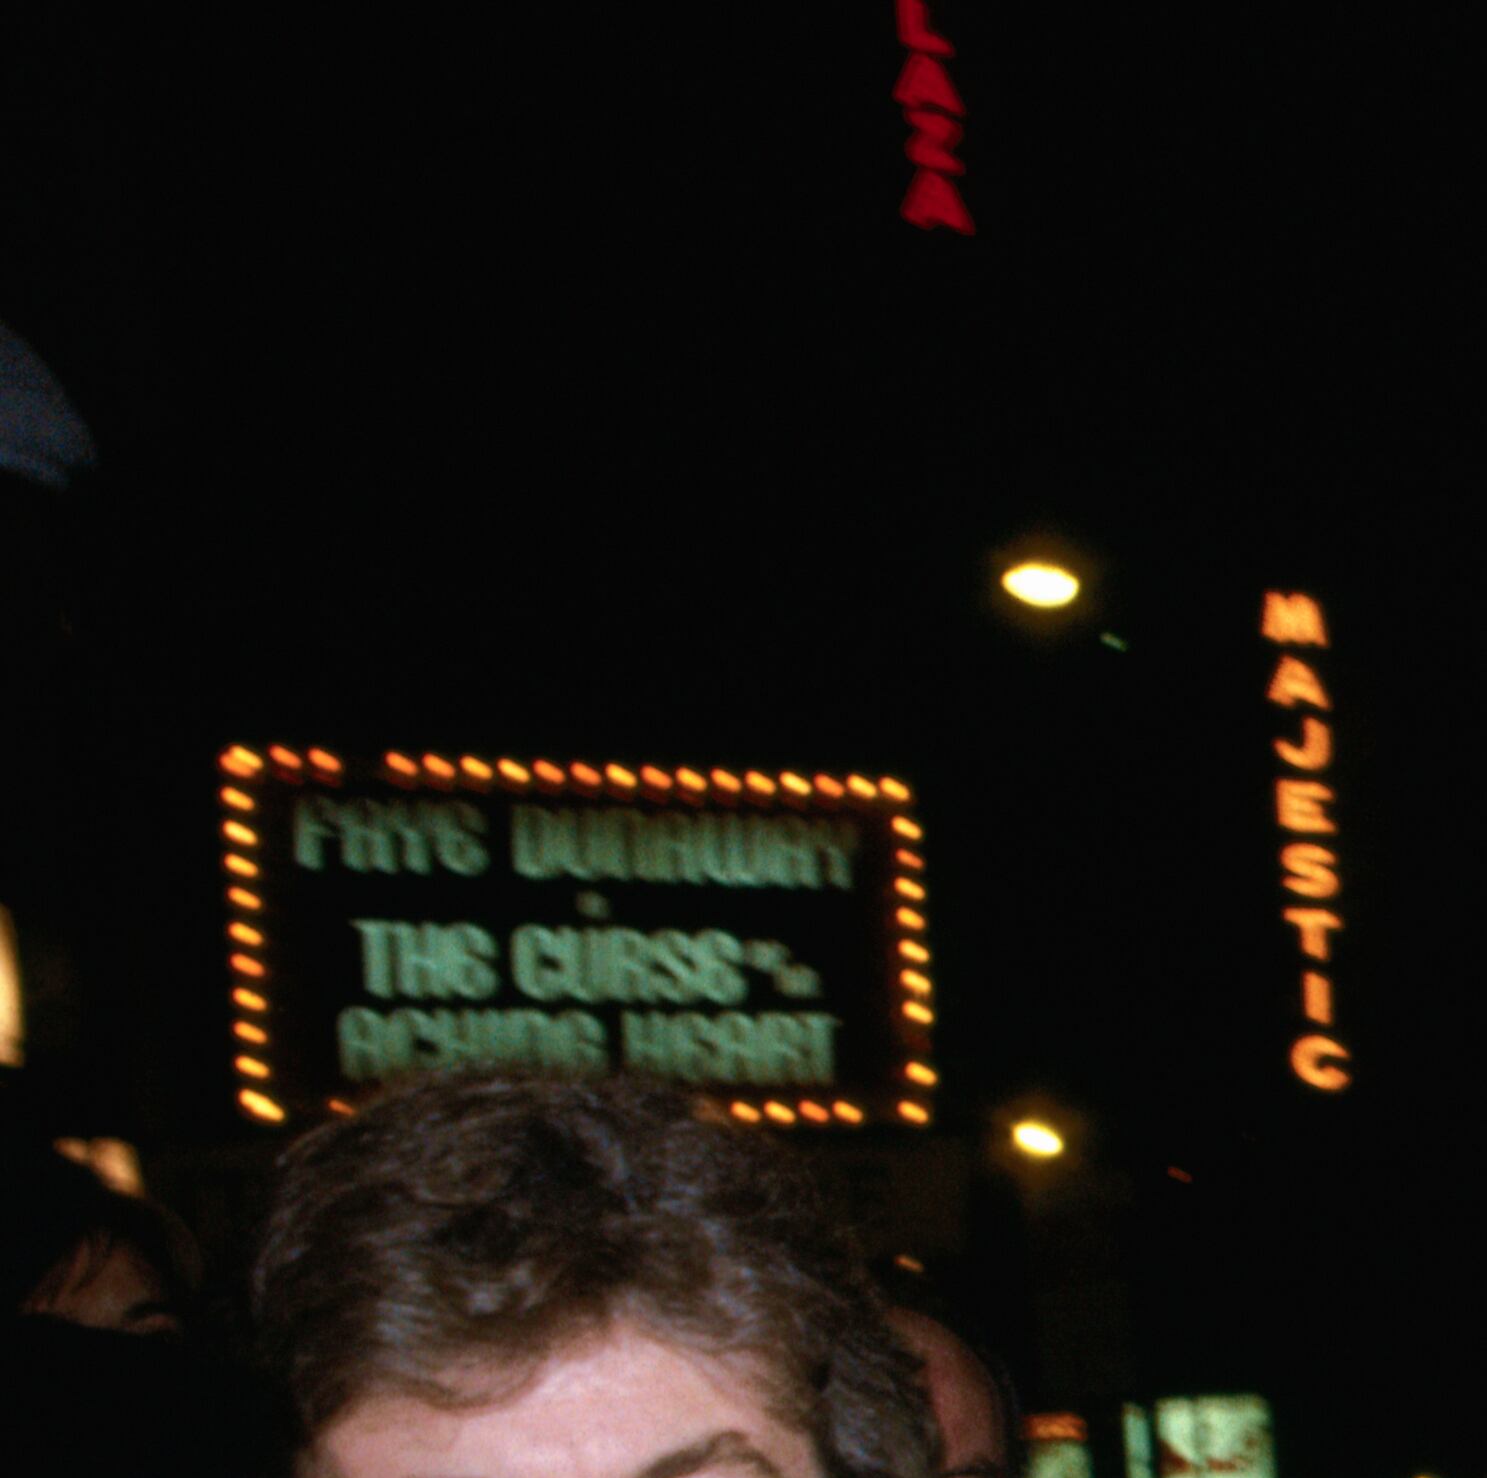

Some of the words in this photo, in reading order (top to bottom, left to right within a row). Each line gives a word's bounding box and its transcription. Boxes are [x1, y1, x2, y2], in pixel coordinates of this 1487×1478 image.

[350, 918, 499, 1000] THE
[510, 923, 749, 1005] CURSE
[1259, 588, 1352, 1091] MAJESTIC
